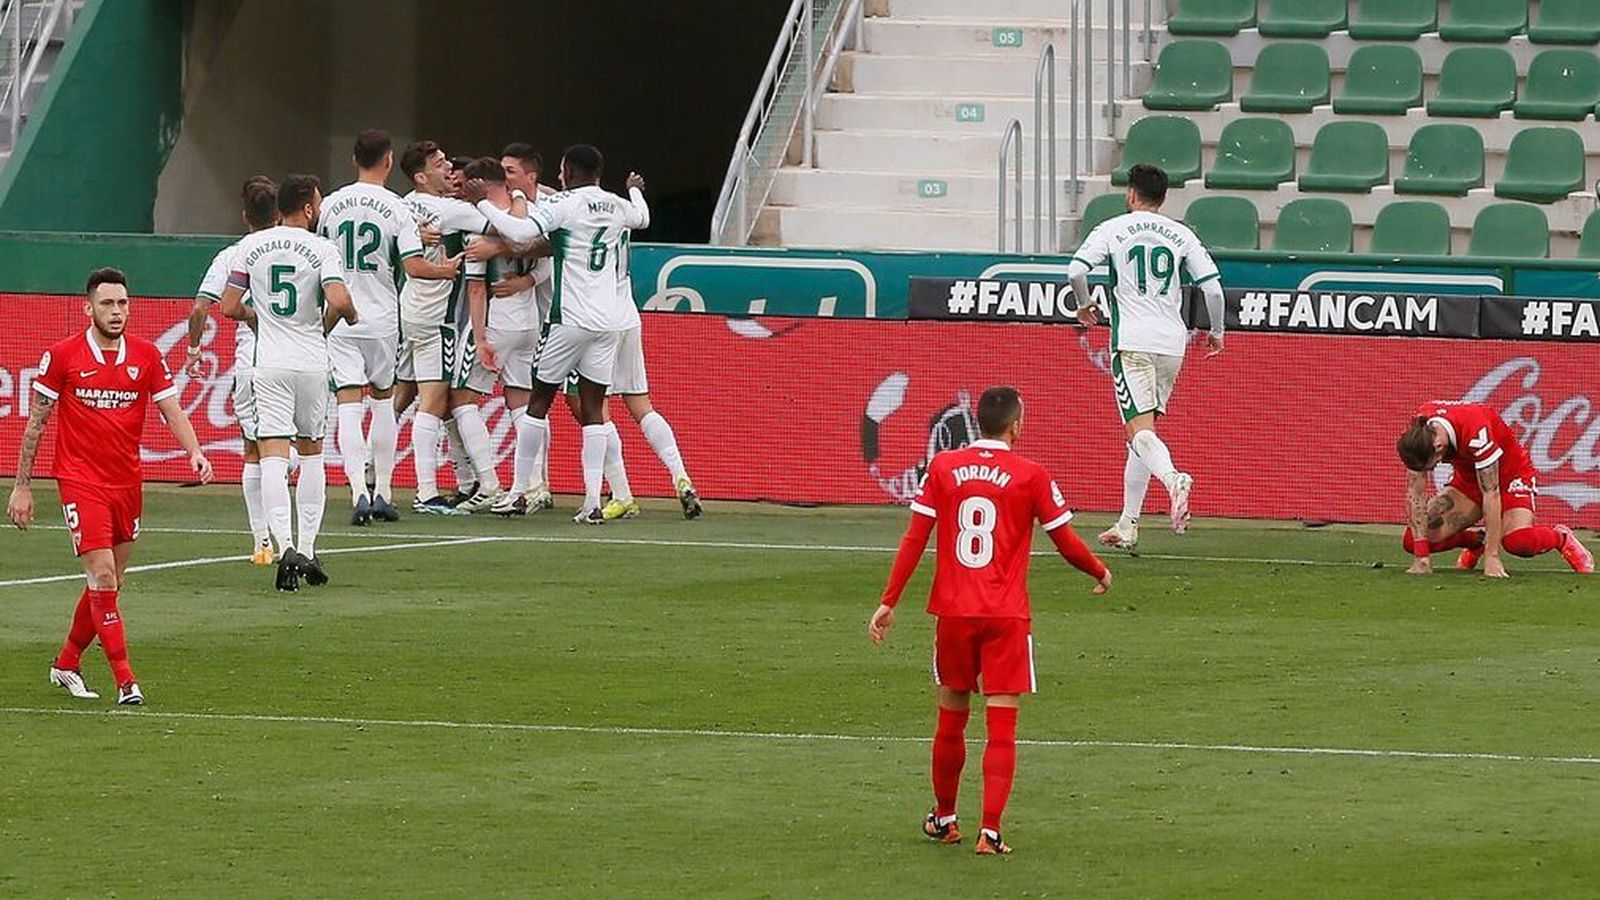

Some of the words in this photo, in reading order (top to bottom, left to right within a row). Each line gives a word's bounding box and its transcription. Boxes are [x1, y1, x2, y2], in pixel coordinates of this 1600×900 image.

[999, 31, 1015, 44] 05
[961, 107, 977, 119] 04
[924, 184, 941, 195] 03
[331, 196, 358, 216] DANI
[360, 196, 392, 219] CALVO
[246, 240, 291, 267] GONZALO
[338, 219, 382, 272] 12
[587, 226, 608, 273] 6
[1126, 245, 1175, 295] 19
[269, 264, 298, 317] 5
[947, 280, 1112, 318] #FANCA
[1238, 291, 1439, 332] #FANCAM
[1521, 301, 1600, 336] #FA
[75, 387, 139, 401] MARATHON
[96, 399, 119, 409] BET
[952, 464, 1012, 489] JORDÁN
[955, 495, 997, 570] 8
